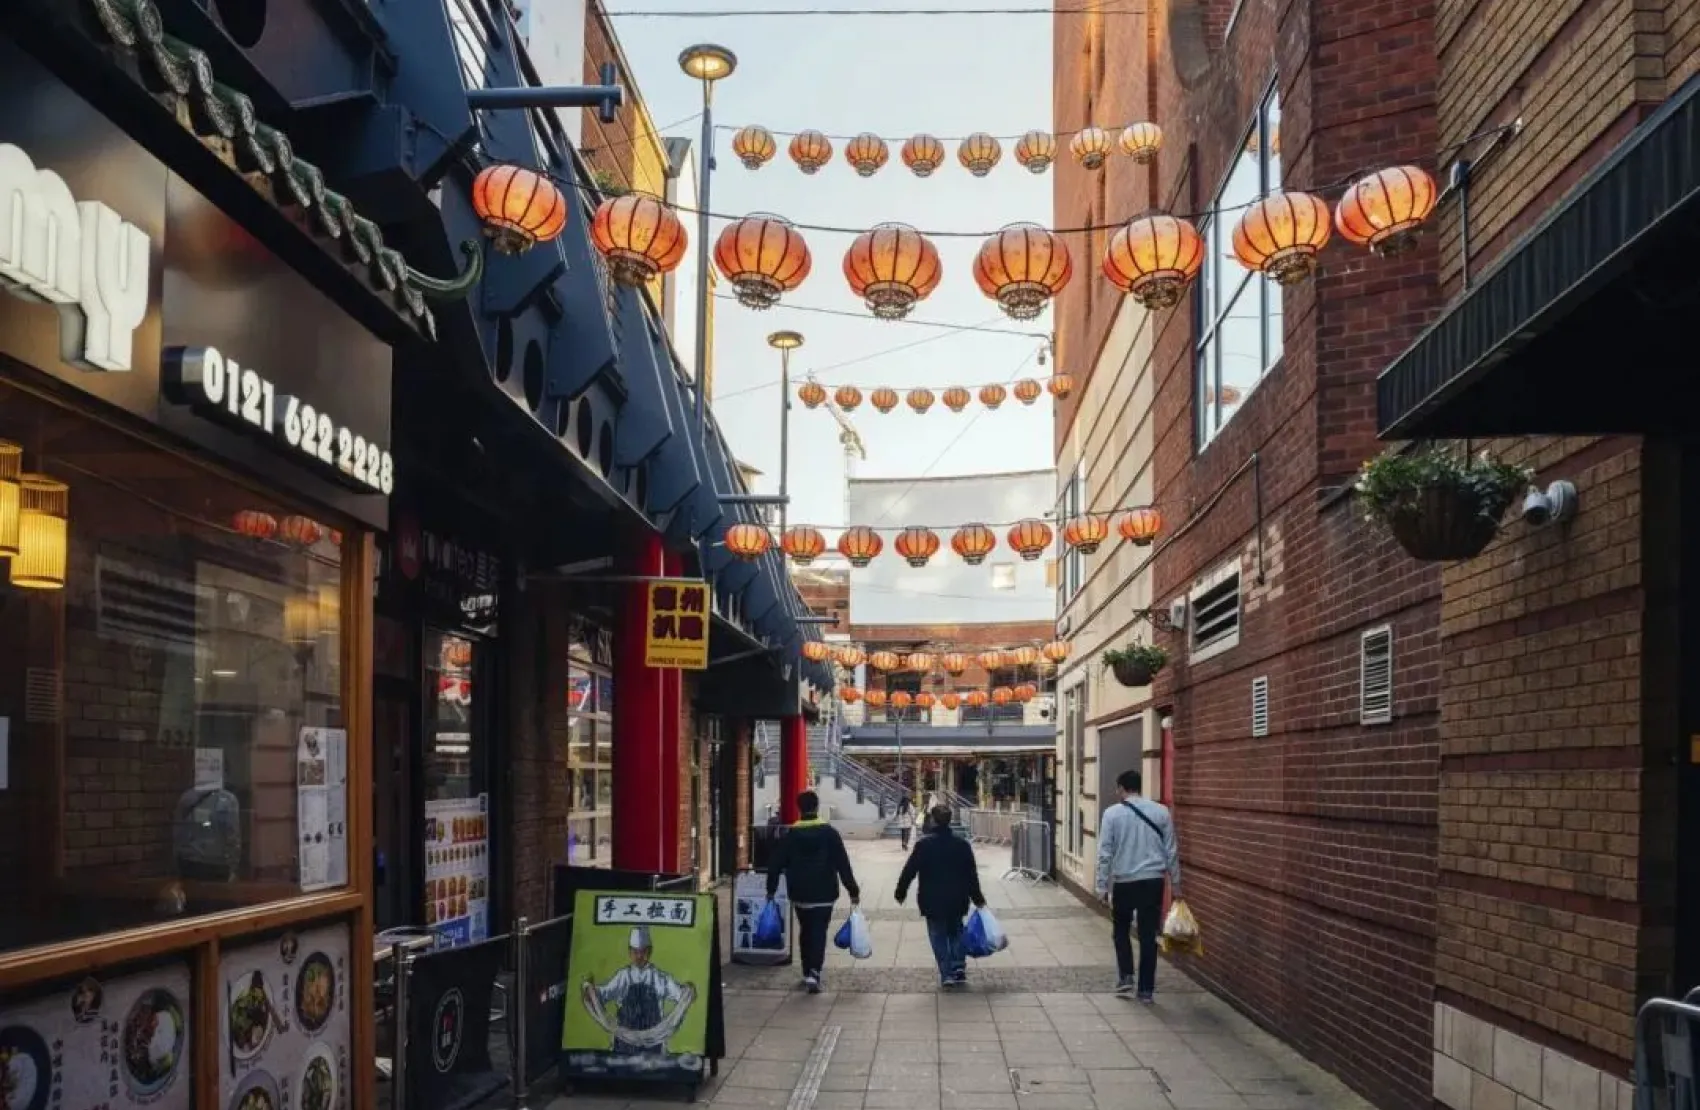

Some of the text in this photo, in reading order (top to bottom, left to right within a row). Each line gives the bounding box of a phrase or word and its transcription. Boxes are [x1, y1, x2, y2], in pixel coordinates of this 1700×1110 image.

[203, 346, 393, 495] 0121 622 2228
